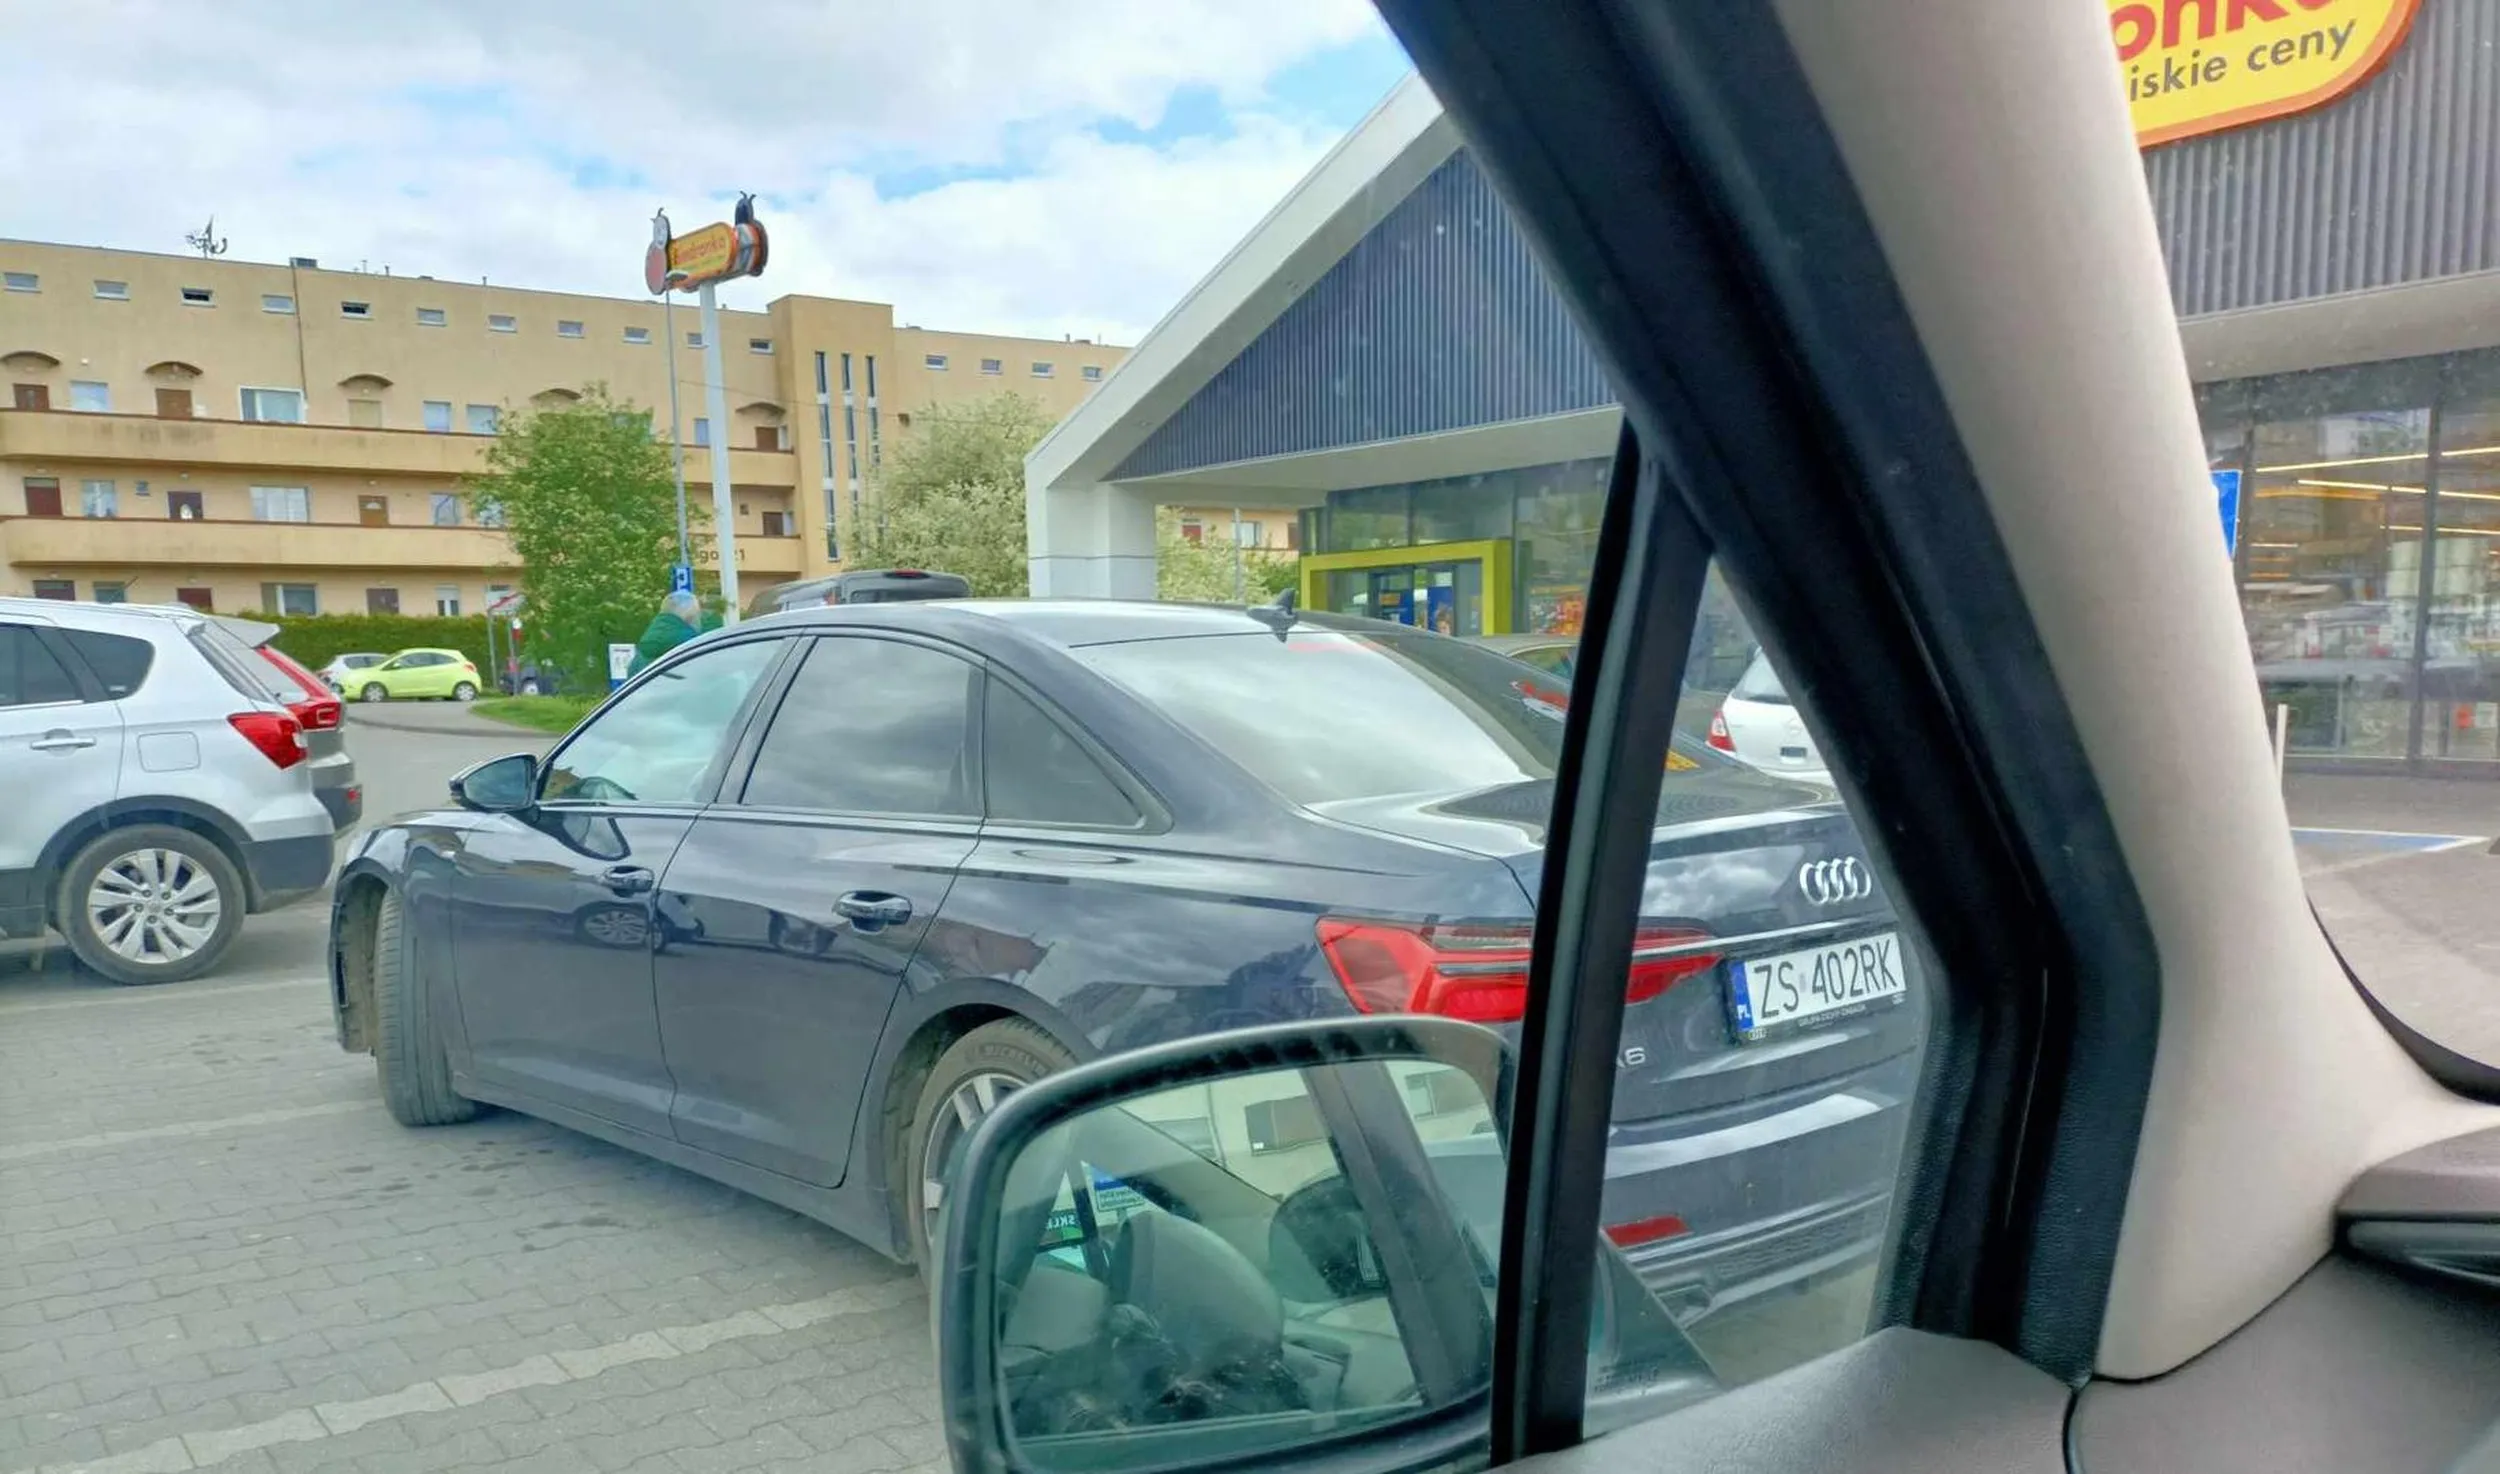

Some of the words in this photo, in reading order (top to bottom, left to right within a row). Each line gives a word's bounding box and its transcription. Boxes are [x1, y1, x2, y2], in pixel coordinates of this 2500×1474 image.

[2110, 0, 2341, 62] onk
[2246, 18, 2357, 72] ceny
[1754, 960, 1800, 1019] ZS
[1811, 938, 1898, 1005] 402RK
[1737, 1003, 1751, 1021] PL
